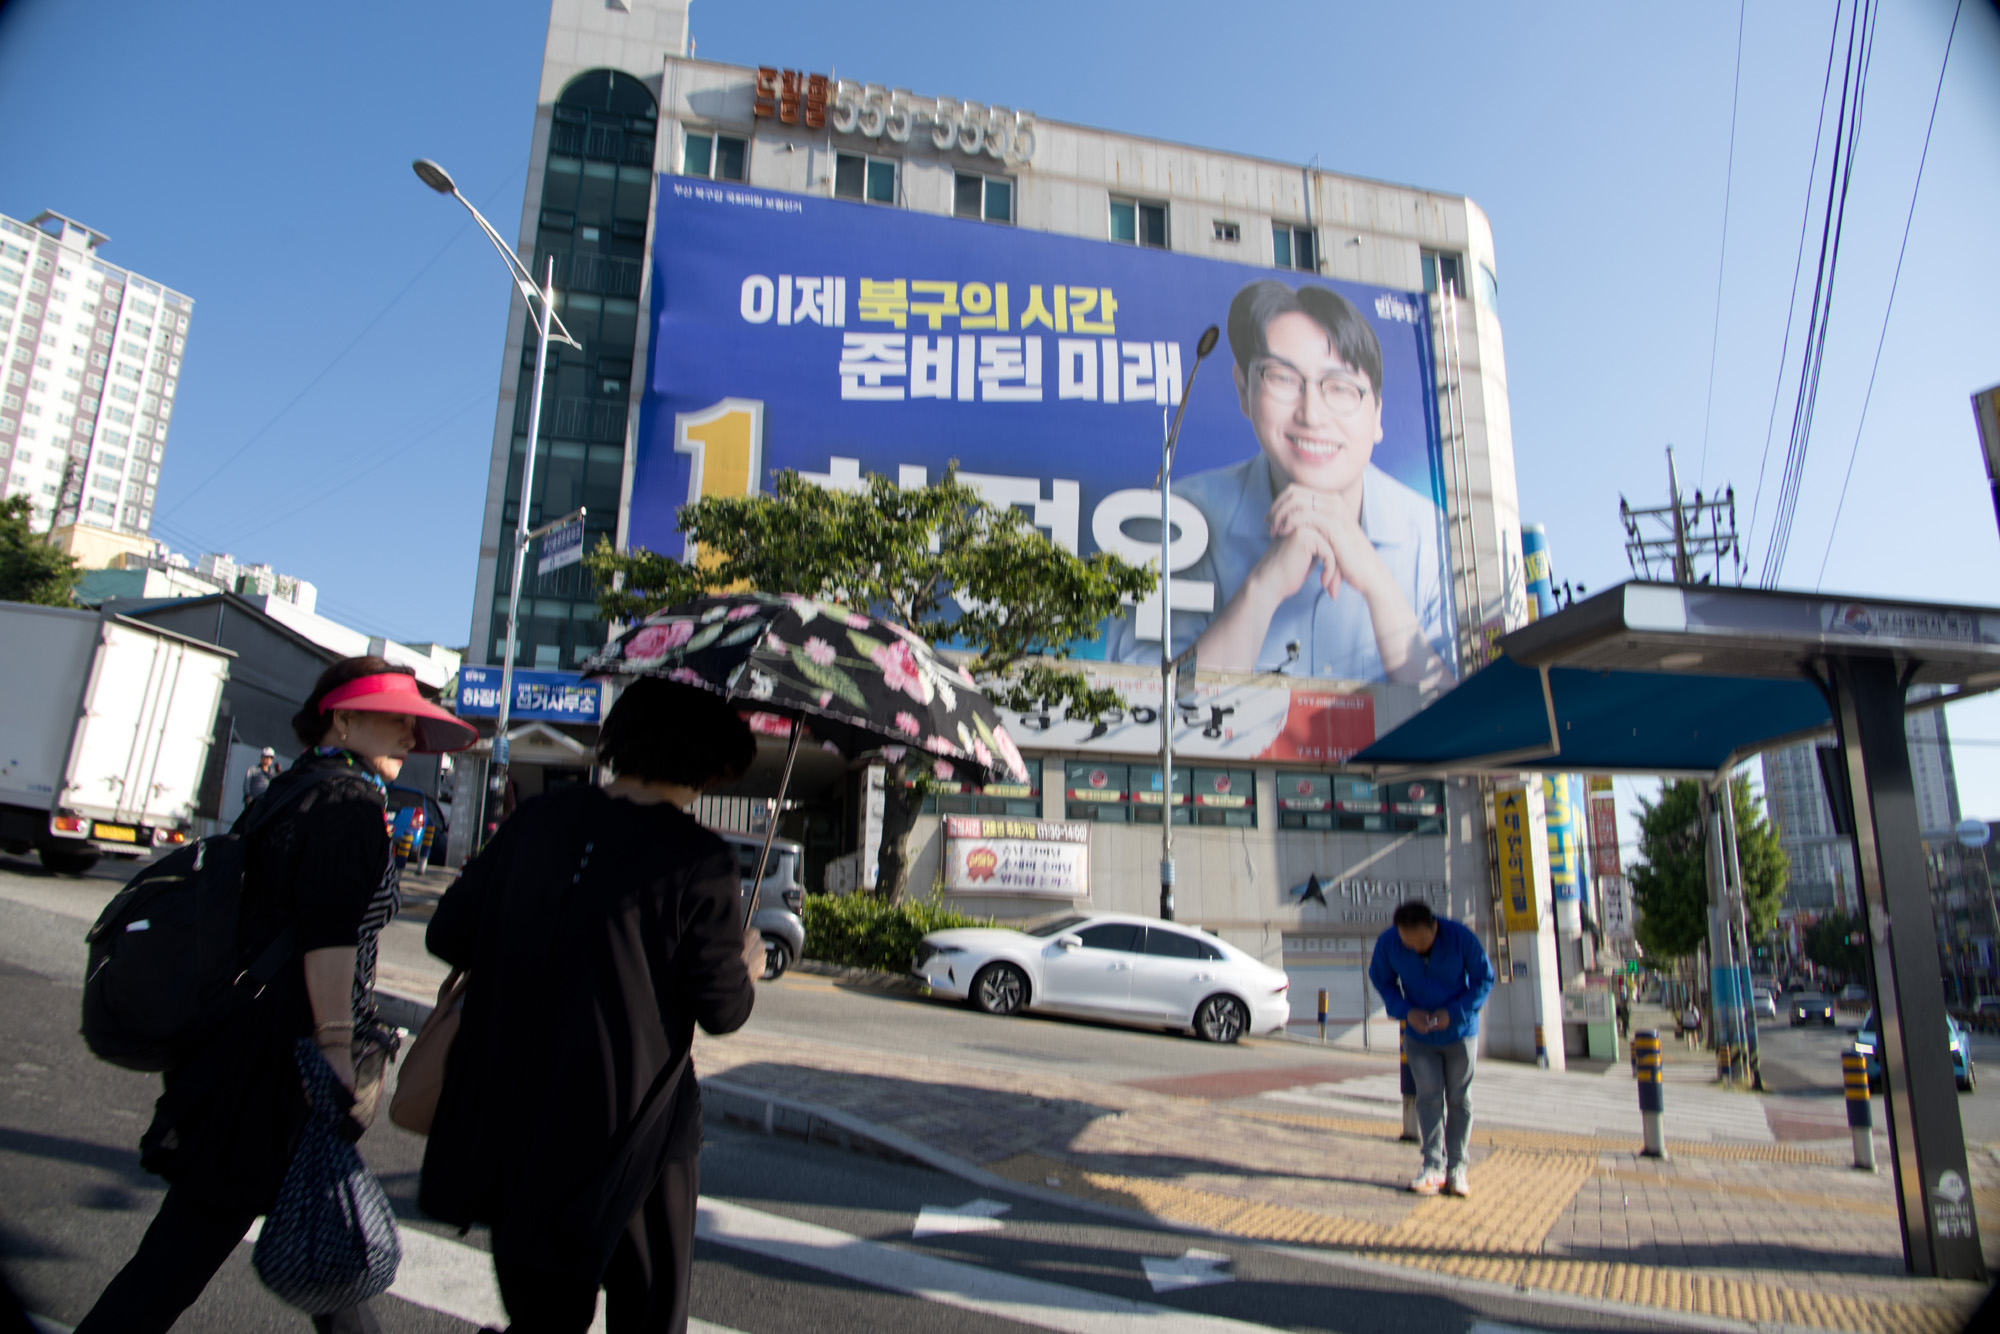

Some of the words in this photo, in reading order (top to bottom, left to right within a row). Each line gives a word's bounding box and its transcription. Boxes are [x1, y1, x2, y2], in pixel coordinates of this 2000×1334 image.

[833, 78, 1036, 162] 555-5555
[740, 274, 845, 327] 이제
[858, 277, 1009, 331] 북구의
[1021, 284, 1118, 334] 시간
[839, 332, 1042, 402] 준비된
[1058, 337, 1182, 406] 미래
[516, 690, 595, 714] 선거사무소
